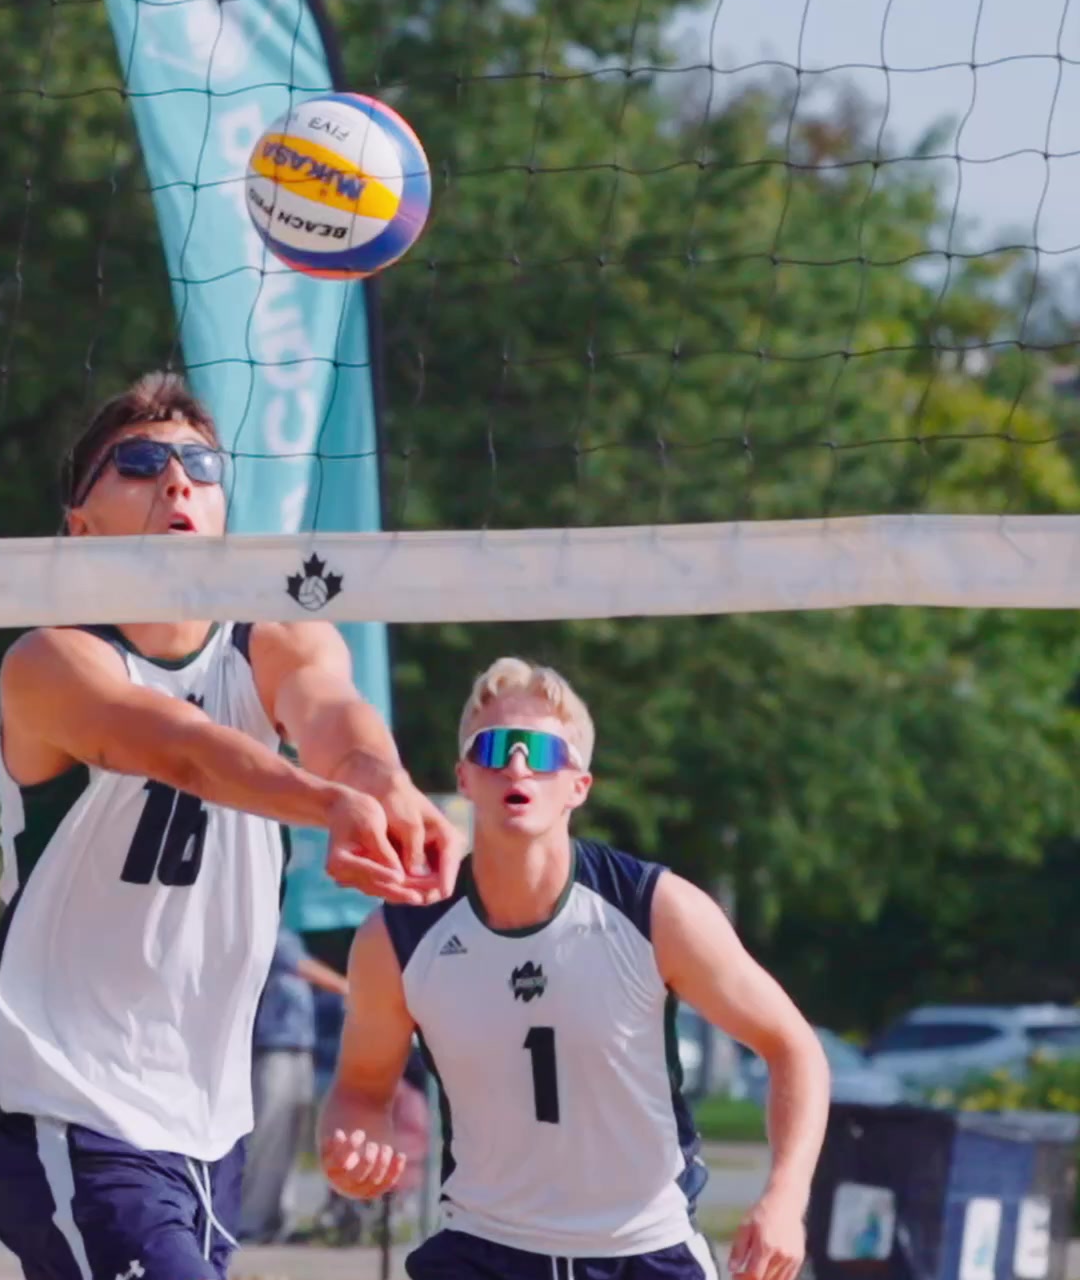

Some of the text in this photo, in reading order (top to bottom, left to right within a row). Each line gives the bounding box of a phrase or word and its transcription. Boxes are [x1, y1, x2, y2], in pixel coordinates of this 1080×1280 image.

[278, 210, 349, 239] BEACH
[219, 101, 318, 463] cana
[522, 1026, 560, 1124] 1
